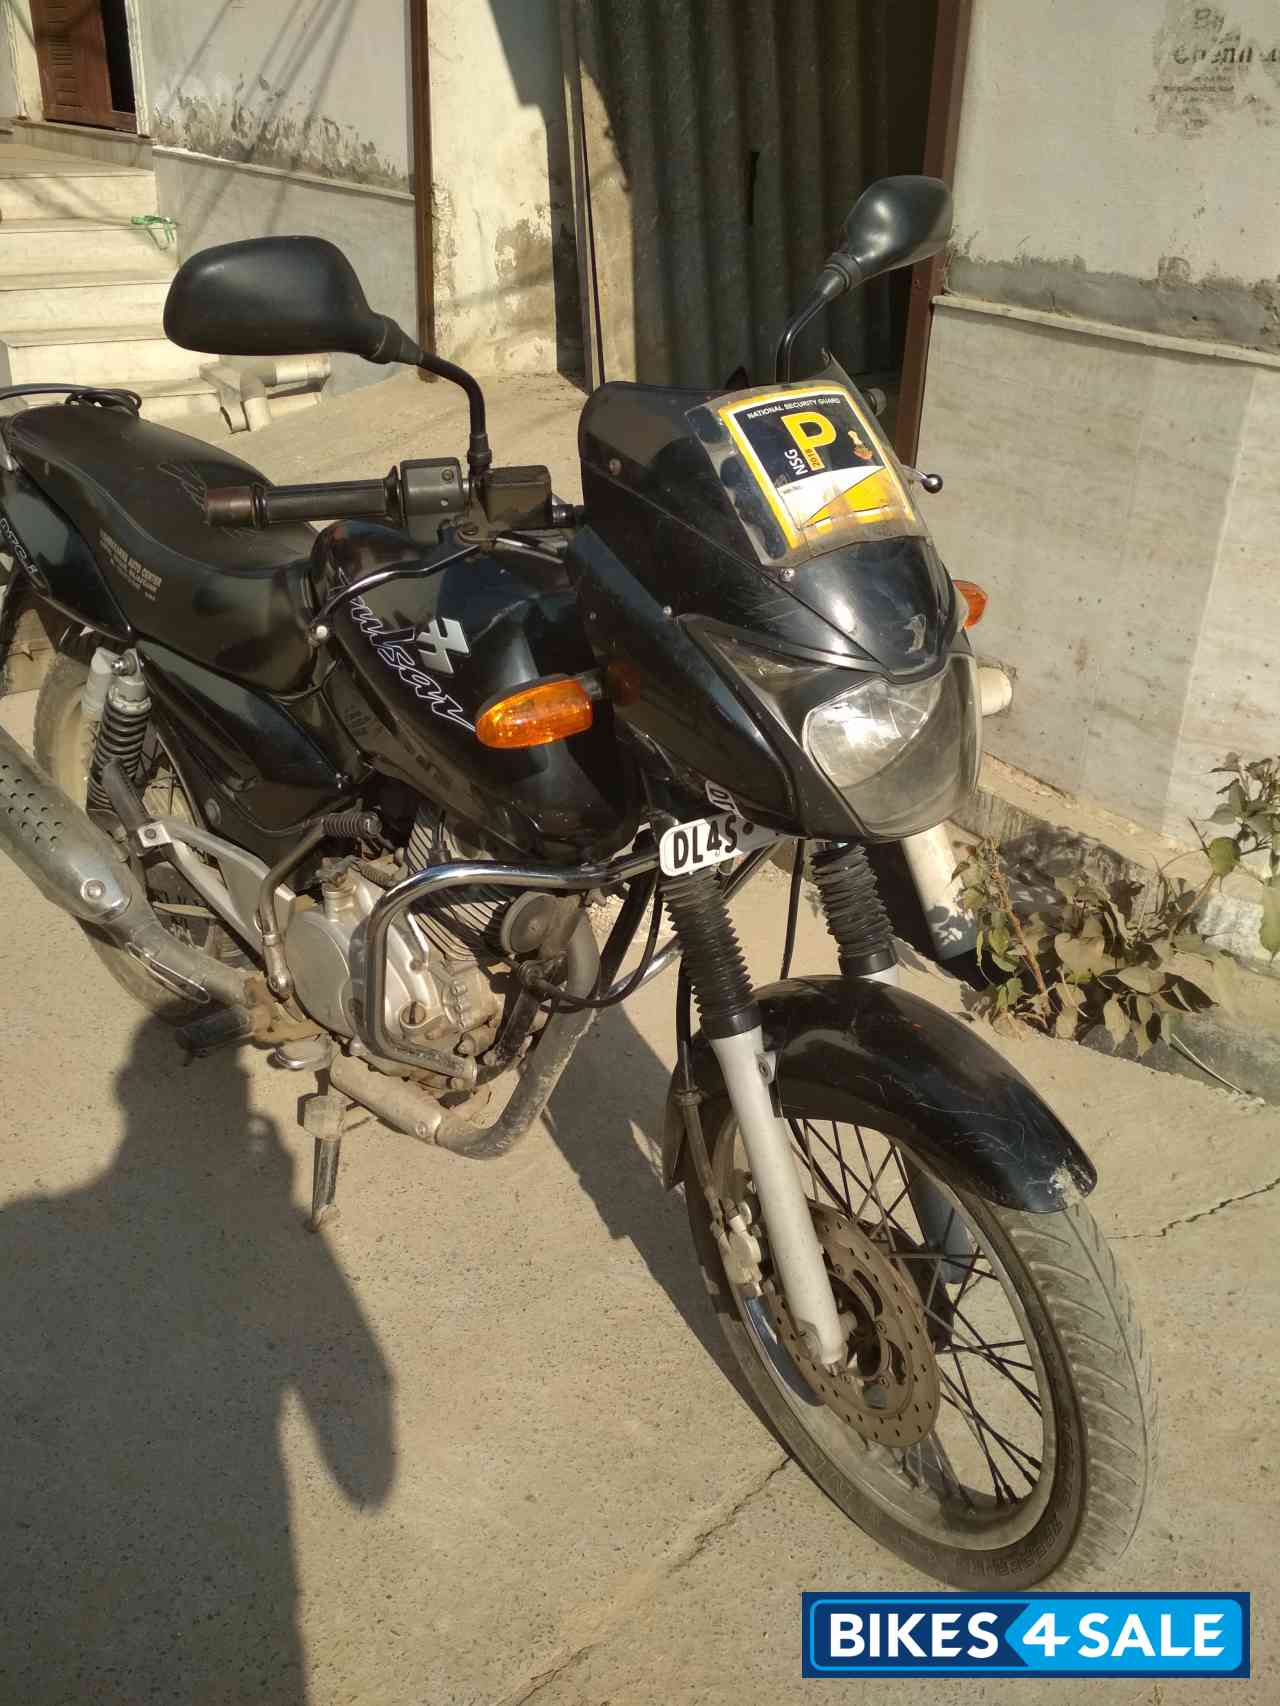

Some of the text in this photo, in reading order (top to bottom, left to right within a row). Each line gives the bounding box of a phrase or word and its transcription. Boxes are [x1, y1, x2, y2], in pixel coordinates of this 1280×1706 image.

[746, 404, 785, 420] NATIONAL
[784, 399, 817, 410] SECURITY
[781, 411, 837, 471] P
[784, 448, 809, 475] NSG
[673, 814, 738, 870] DL4S
